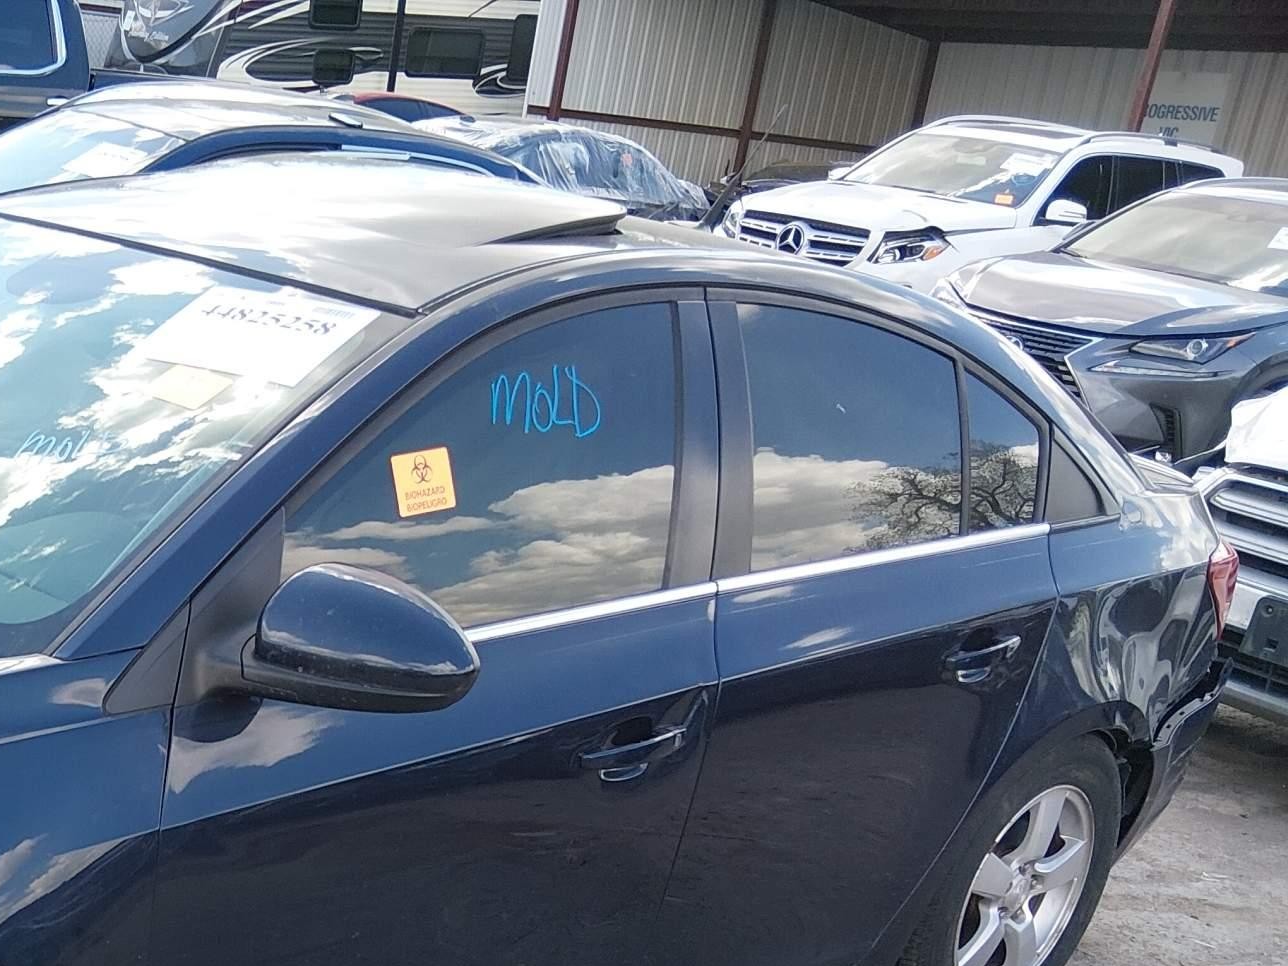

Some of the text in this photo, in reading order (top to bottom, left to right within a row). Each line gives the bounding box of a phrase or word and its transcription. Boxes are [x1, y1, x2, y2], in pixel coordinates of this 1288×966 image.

[1144, 103, 1220, 122] OGRESSIVE
[201, 304, 337, 335] 44825258
[491, 364, 601, 437] MOLD
[404, 486, 446, 500] BIOHAZARD
[406, 497, 447, 512] BIOPELIGRO
